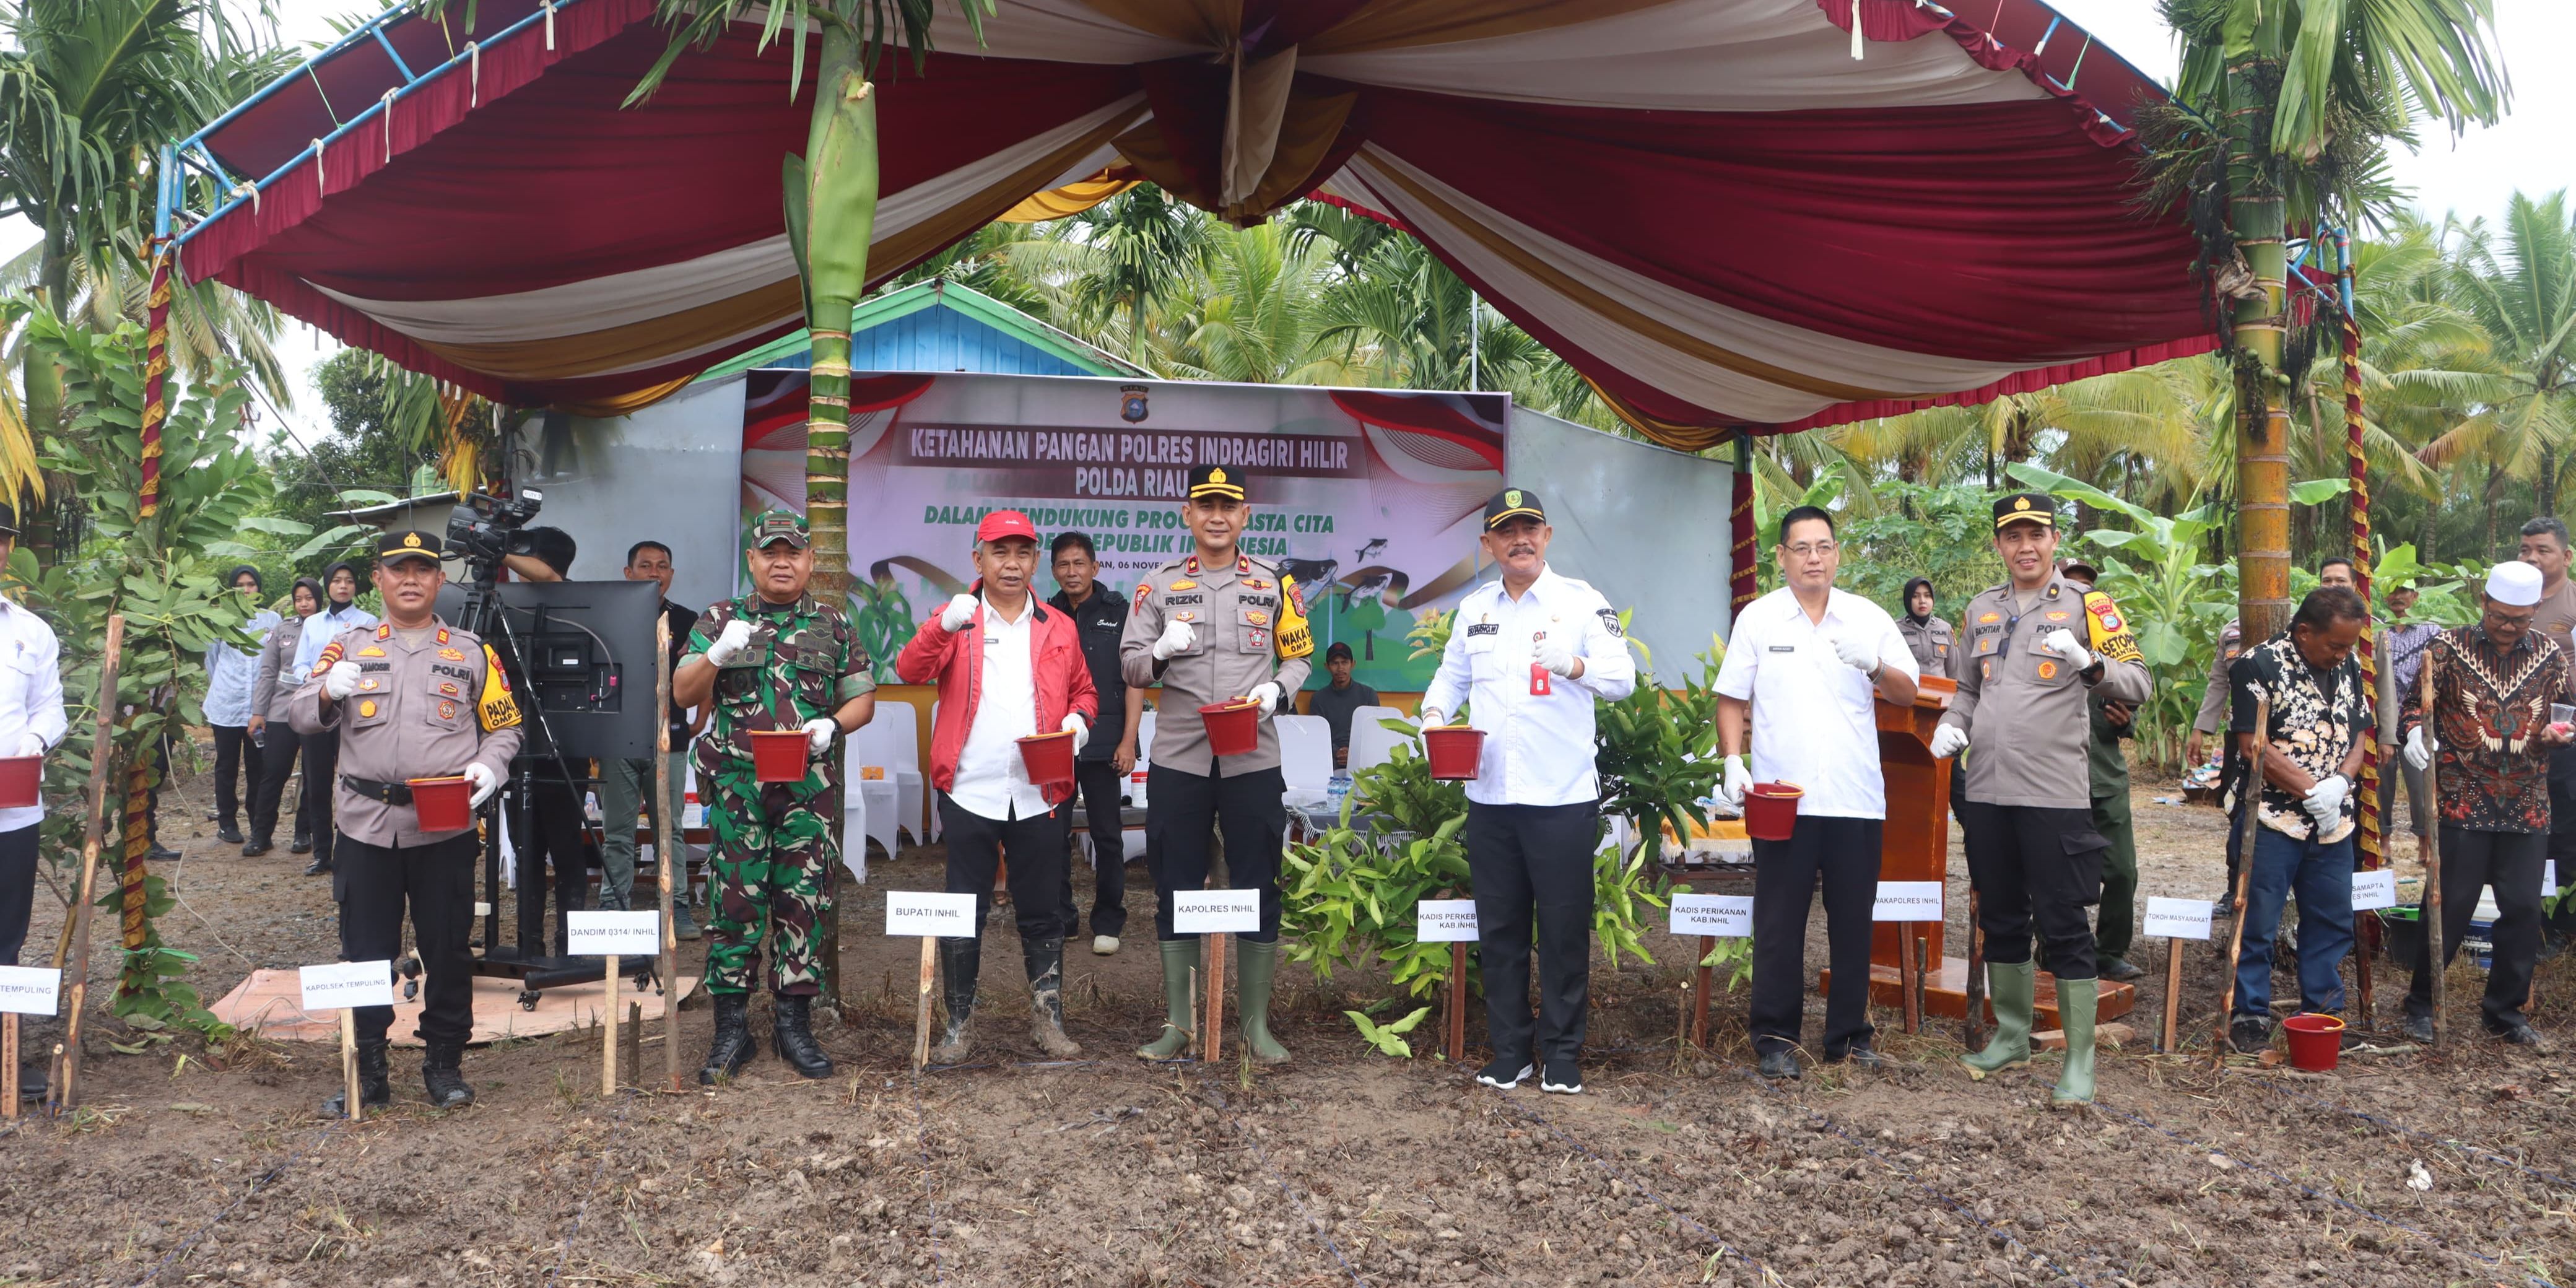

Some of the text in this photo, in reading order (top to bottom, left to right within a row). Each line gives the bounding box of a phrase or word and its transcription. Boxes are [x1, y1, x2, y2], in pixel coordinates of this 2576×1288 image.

[911, 428, 1348, 469] KETAHANAN PANGAN POLRES INDRAGIRI HILIR
[1076, 466, 1188, 497] POLDA RIAU
[1294, 515, 1334, 533] CITA
[1095, 533, 1173, 553] EPUBLIK
[1165, 594, 1203, 606] RIZKI
[1238, 595, 1274, 607] POLRI
[1279, 627, 1307, 647] WAKA
[1975, 625, 2001, 637] BACHTIAR
[1291, 641, 1307, 652] OMP
[432, 664, 471, 680] POLRI
[486, 696, 516, 720] PADAL
[492, 713, 512, 726] OMP
[896, 908, 960, 918] BUPATI INHIL
[1178, 905, 1255, 913] KAPOLRES INHIL
[1701, 907, 1747, 916] PERIKANAN
[1690, 916, 1730, 924] KAB.INHIL
[2169, 915, 2209, 923] MASYARAKAT
[1, 985, 51, 994] TEMPULING
[306, 979, 386, 991] KAPOLSEK TEMPULING
